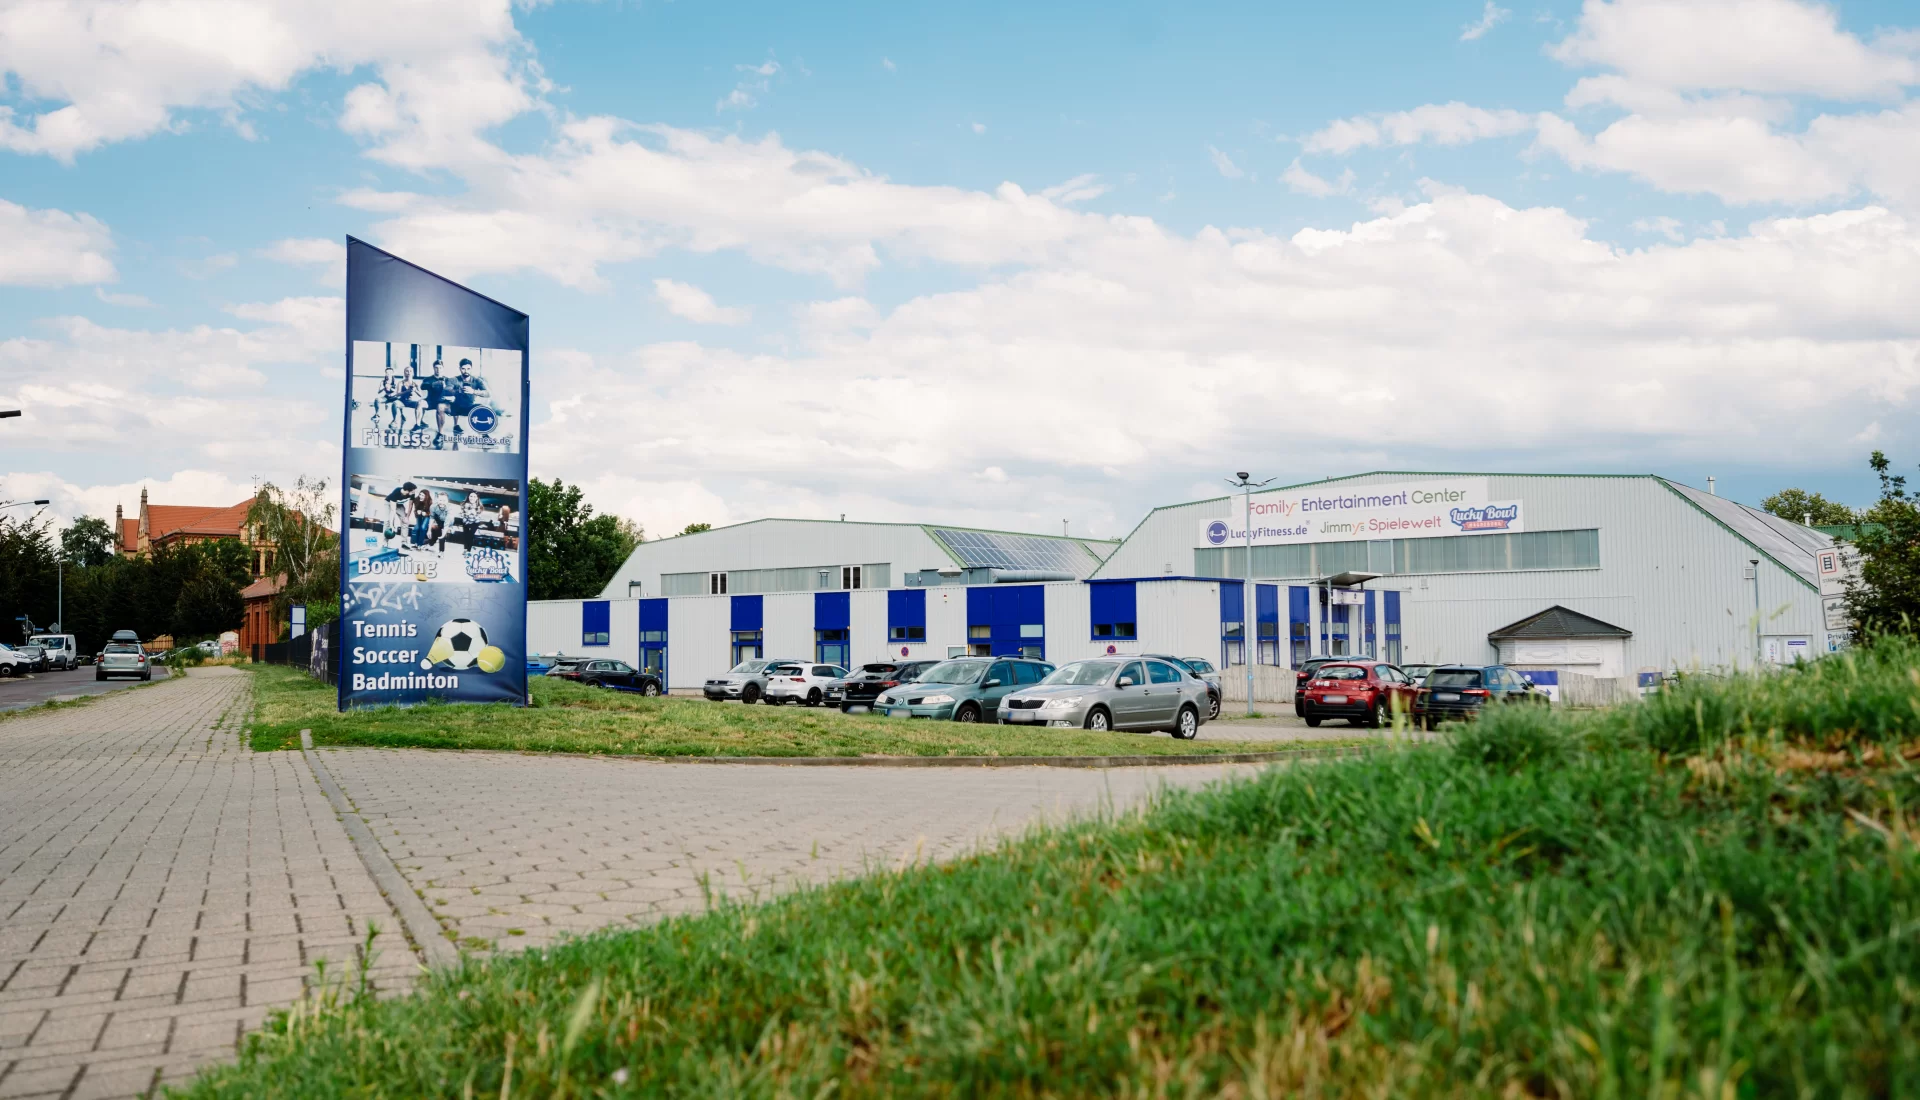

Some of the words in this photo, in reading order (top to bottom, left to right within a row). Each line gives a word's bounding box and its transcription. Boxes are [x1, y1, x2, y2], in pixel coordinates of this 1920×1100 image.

[362, 427, 431, 447] Fitness
[443, 434, 511, 445] LuckyFitness.de
[1250, 500, 1298, 516] Family
[1302, 490, 1407, 512] Entertainment
[1411, 488, 1466, 504] Center
[1451, 508, 1484, 523] Lucky
[1486, 506, 1516, 519] Bowl
[1368, 516, 1441, 533] Spielewelt
[358, 556, 437, 578] Bowling
[352, 620, 417, 638] Tennis
[352, 646, 418, 664] Soccer
[352, 672, 458, 691] Badminton
